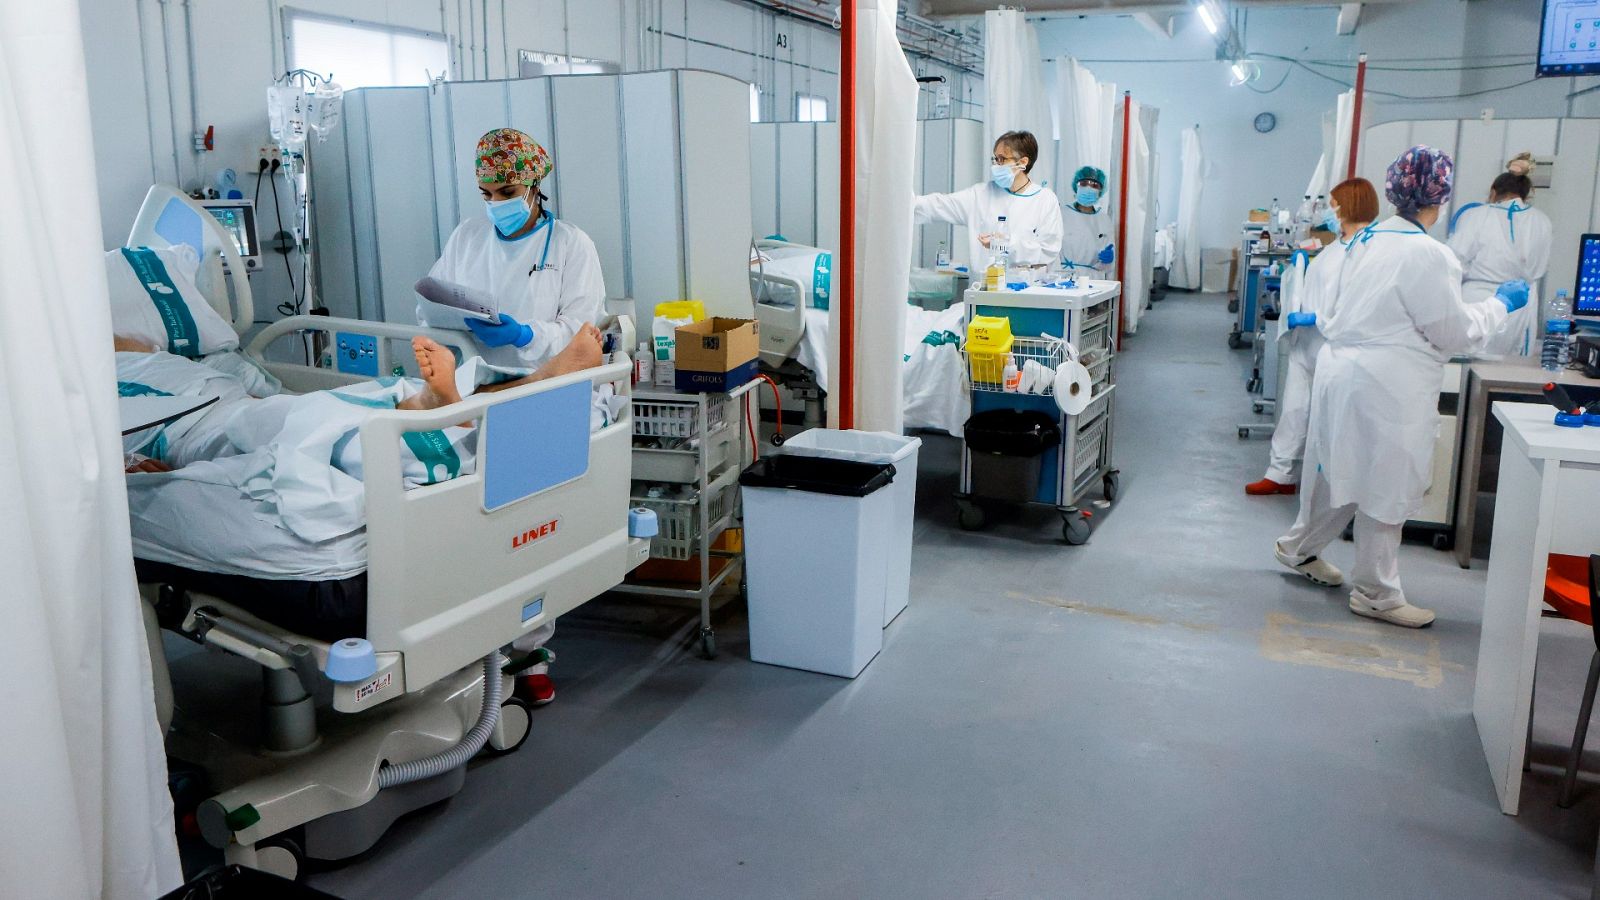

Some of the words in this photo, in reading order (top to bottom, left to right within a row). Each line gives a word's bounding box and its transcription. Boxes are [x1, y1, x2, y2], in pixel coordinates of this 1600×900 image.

[776, 32, 787, 49] A3
[692, 375, 723, 384] GRIFOLS
[512, 519, 559, 549] LINET
